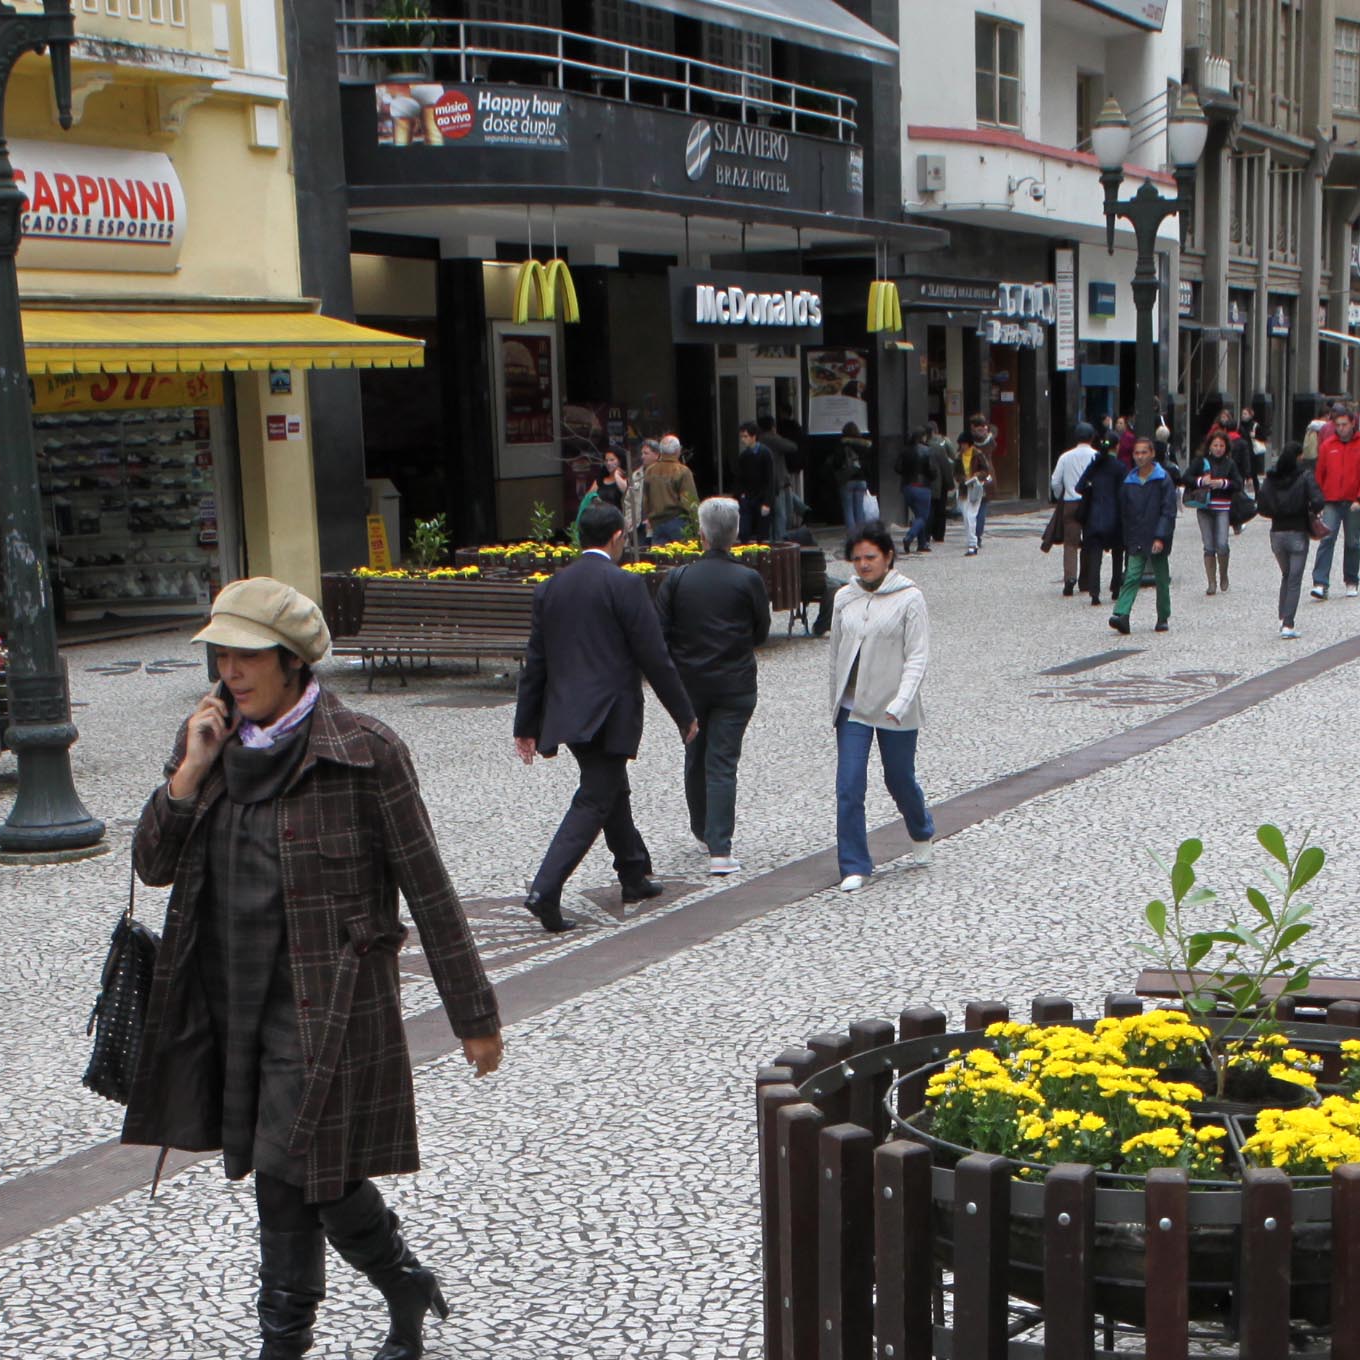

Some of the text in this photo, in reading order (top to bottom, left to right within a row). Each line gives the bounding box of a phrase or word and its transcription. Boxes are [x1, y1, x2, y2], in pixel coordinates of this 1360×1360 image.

[435, 101, 468, 114] música
[478, 91, 562, 117] Happy hour
[437, 113, 471, 126] ao vivo
[482, 113, 556, 136] dose dupla
[714, 122, 789, 162] SLAVIERO
[716, 165, 789, 192] BRAZ HOTEL
[85, 219, 92, 233] E
[97, 219, 174, 240] ESPORTES
[696, 284, 822, 327] McDonald's
